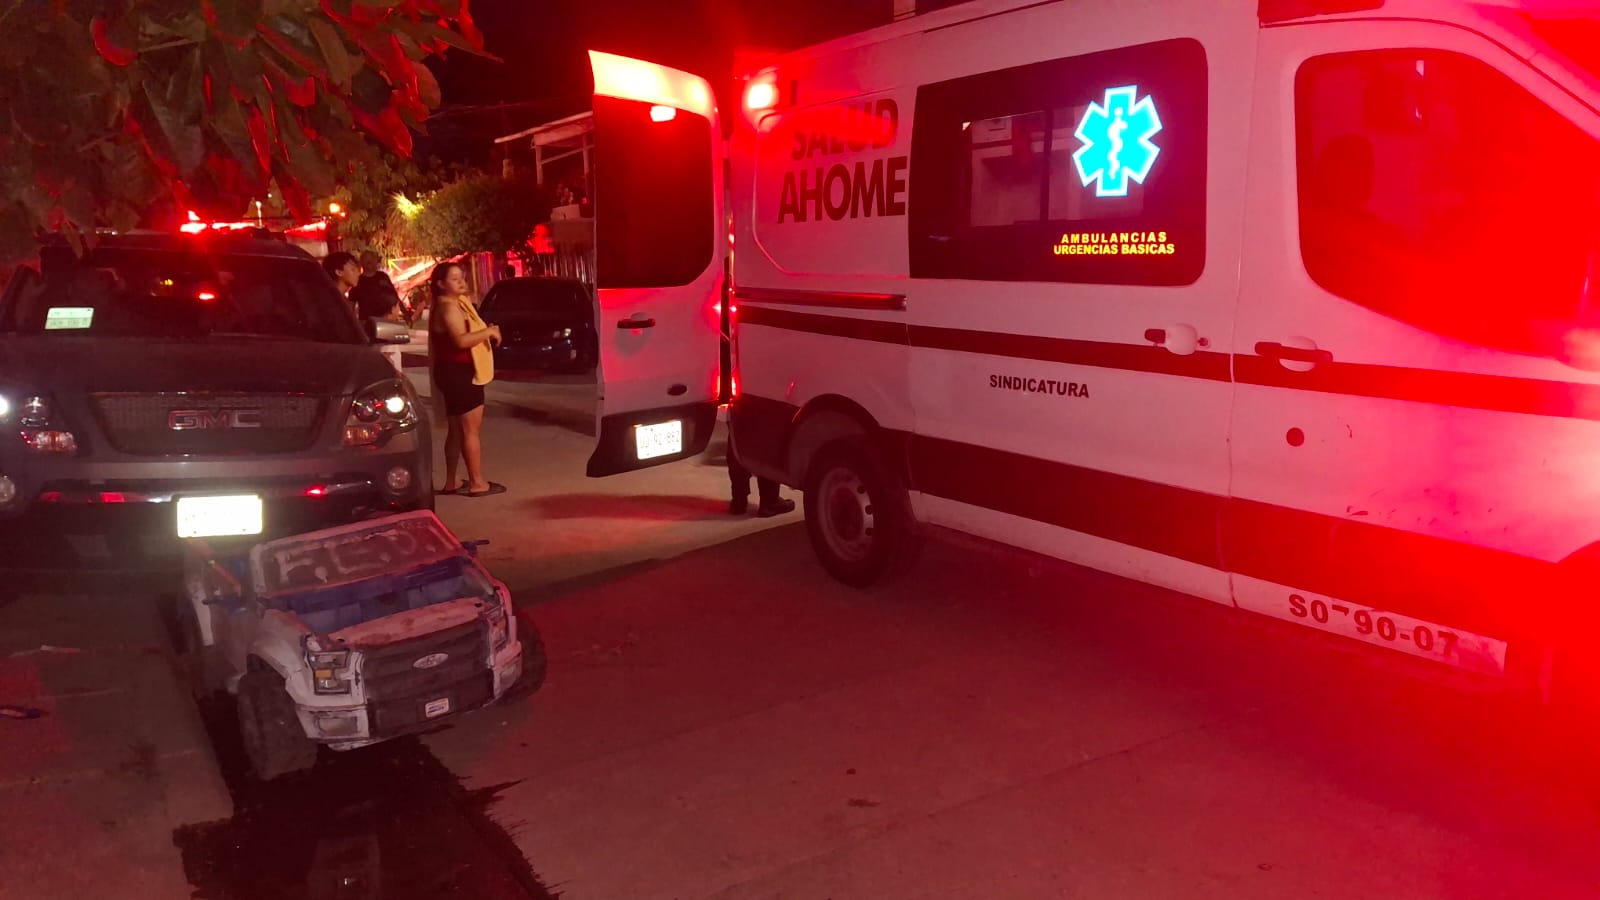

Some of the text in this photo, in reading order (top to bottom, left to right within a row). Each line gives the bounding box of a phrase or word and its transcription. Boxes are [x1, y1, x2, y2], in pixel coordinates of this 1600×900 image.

[777, 156, 908, 224] AHOME
[1061, 231, 1167, 243] AMBULANCIAS
[1053, 243, 1175, 255] URGENCIAS BASICAS
[989, 374, 1089, 398] SINDICATURA
[168, 409, 262, 429] GMC
